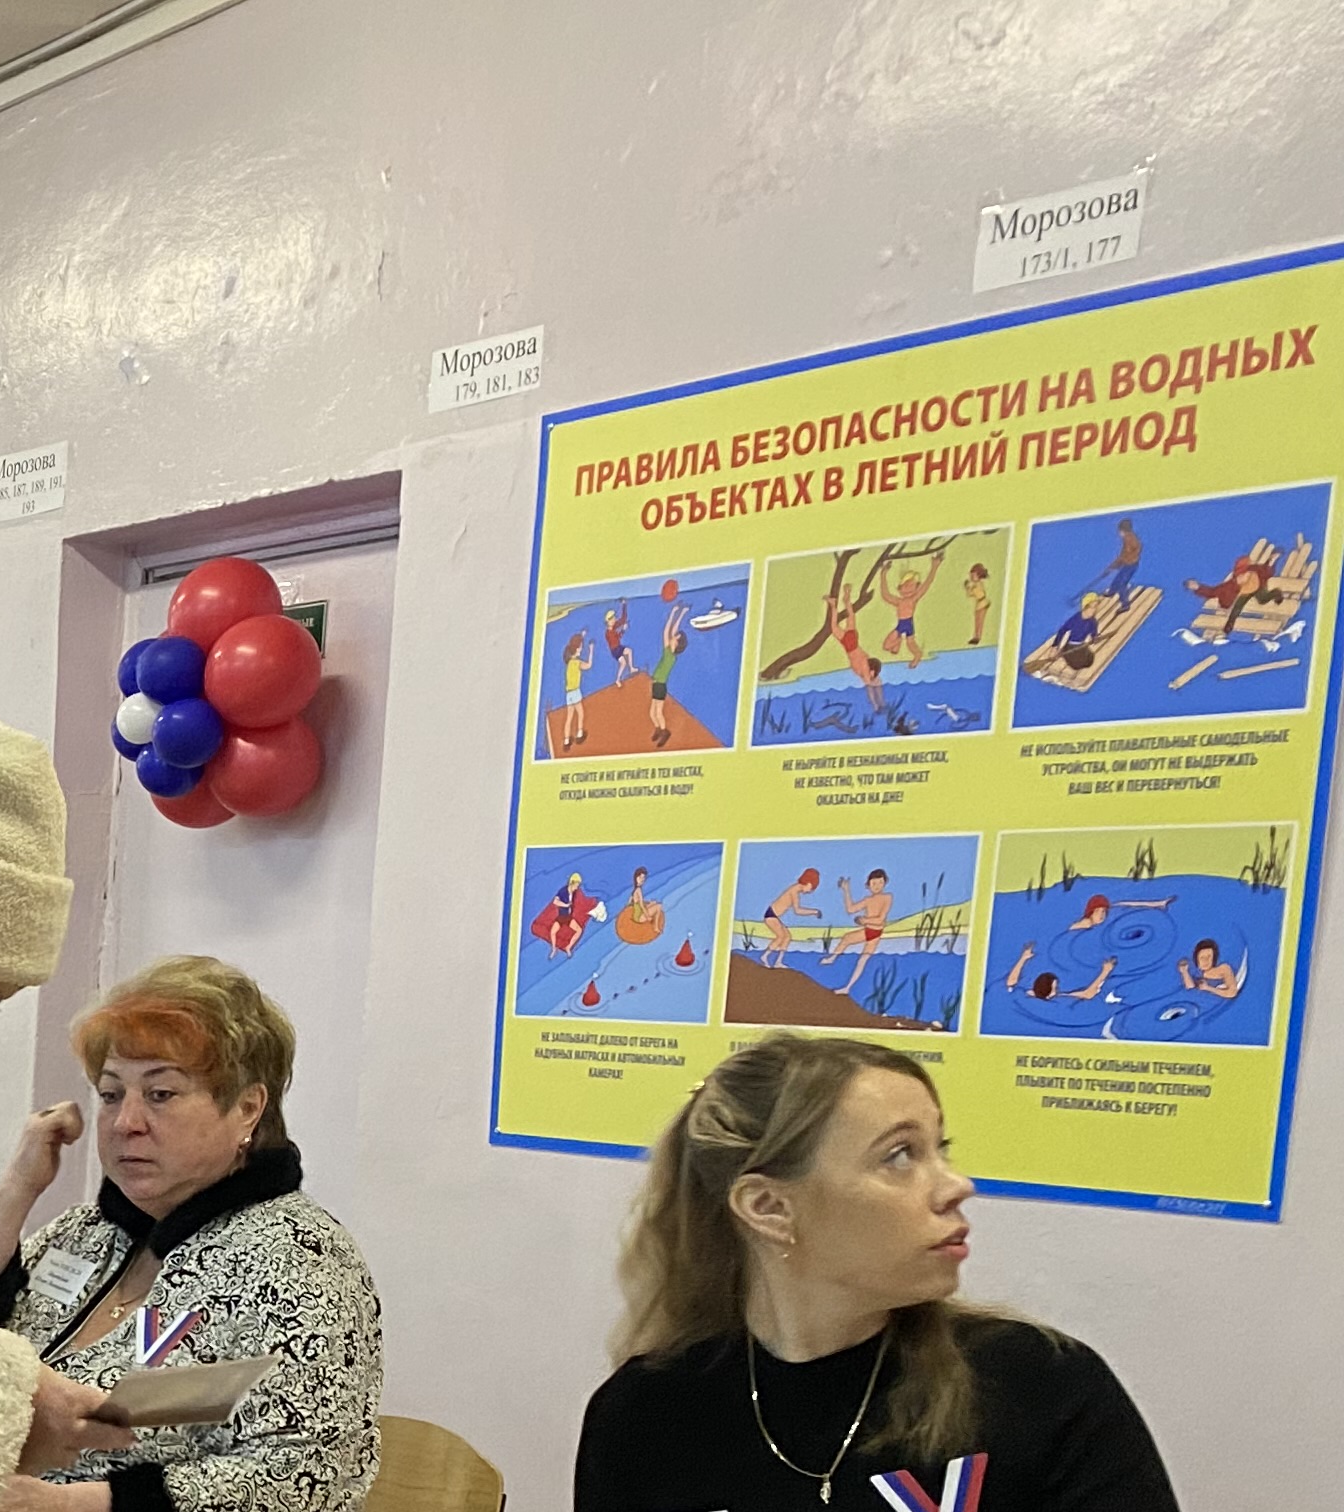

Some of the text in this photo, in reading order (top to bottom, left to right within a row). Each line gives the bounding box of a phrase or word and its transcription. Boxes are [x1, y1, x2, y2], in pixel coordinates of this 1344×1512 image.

[990, 188, 1138, 244] Морозова
[1019, 235, 1122, 279] 173/1, 177
[440, 336, 537, 377] Морозова
[456, 366, 540, 402] 179, 181, 183
[574, 324, 1319, 498] ПРАВИЛА БЕЗОПАСНОСТИ НА ВОДНЫХ
[640, 405, 1198, 531] ОБЪЕКТАХ В ЛЕТНИЙ ПЕРИОД
[13, 483, 28, 497] 187,
[49, 475, 65, 490] 191,
[22, 500, 35, 514] 193
[1020, 729, 1290, 757] НЕ ИСПОЛЬЗУЙТЕ ПЛАВАТЕЛЬНЫЕ САМОДЕЛЬНЫЕ
[783, 759, 793, 771] НЕ
[795, 756, 836, 770] НЫРЯЙТЕ
[847, 753, 908, 767] НЕЗНАКОМЫХ
[912, 751, 949, 764] МЕСТАХ,
[1042, 760, 1109, 776] УСТРОЙСТВА,
[1130, 757, 1166, 771] МОГУТ
[1169, 756, 1181, 768] НЕ
[1185, 752, 1258, 768] ВЫДЕРЖАТЬ
[561, 774, 569, 784] НЕ
[795, 771, 930, 788] НЕ ИЗВЕСТНО, ЧТО ТАМ МОЖЕТ
[1068, 776, 1221, 794] ВАШ ВЕС И ПЕРЕВЕРНУТЬСЯ!
[817, 792, 865, 806] ОКАЗАТЬСЯ
[868, 792, 880, 803] НА
[1016, 1056, 1214, 1078] НЕ БОРИТЕСЬ С СИЛЬНЫМ ТЕЧЕНИЕМ,
[1016, 1075, 1211, 1097] ПЛЫВИТЕ ПО ТЕЧЕНИЮ ПОСТЕПЕННО
[1042, 1096, 1177, 1116] ПРИБЛИЖАЯСЬ К БЕРЕГУ!
